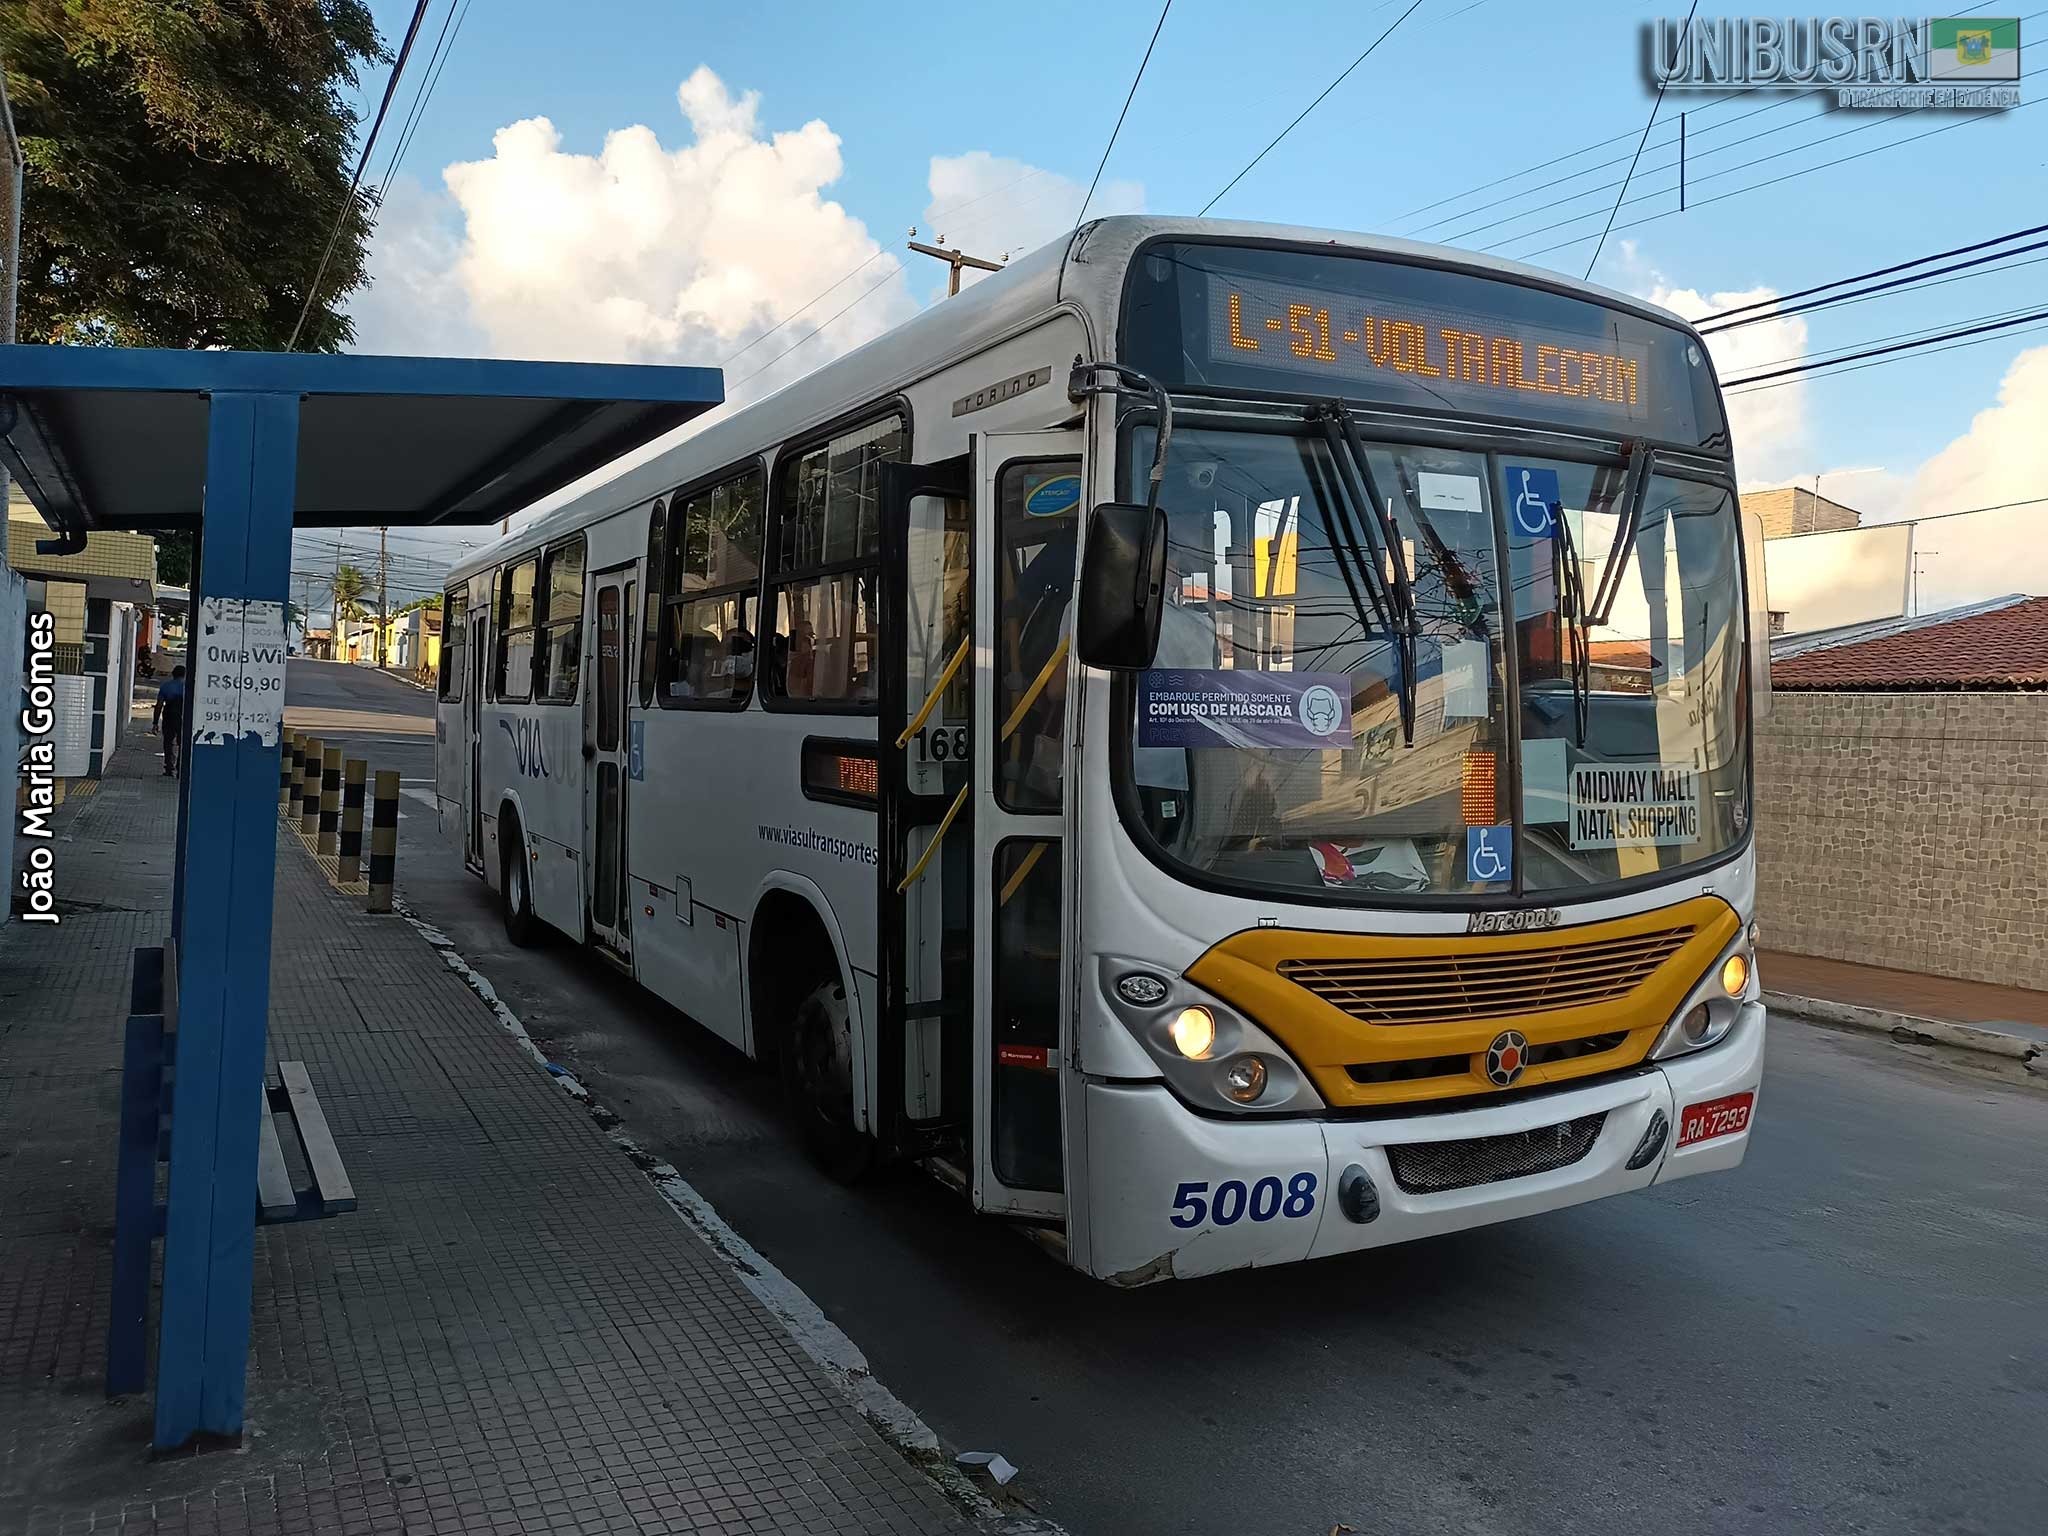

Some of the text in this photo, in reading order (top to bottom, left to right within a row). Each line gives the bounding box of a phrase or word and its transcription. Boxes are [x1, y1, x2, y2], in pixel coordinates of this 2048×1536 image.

[964, 373, 1036, 411] TORINO
[207, 674, 281, 694] R$69,90
[1149, 692, 1292, 703] EMBARQUE PERMITIDO SOMENTE
[1149, 701, 1293, 717] COM USO DE MÁSCARA
[1576, 770, 1696, 804] MIDWAY MALL
[1577, 806, 1697, 840] NATAL SHOPPING
[1468, 908, 1561, 932] Marcopolo
[1169, 1171, 1318, 1229] 5008
